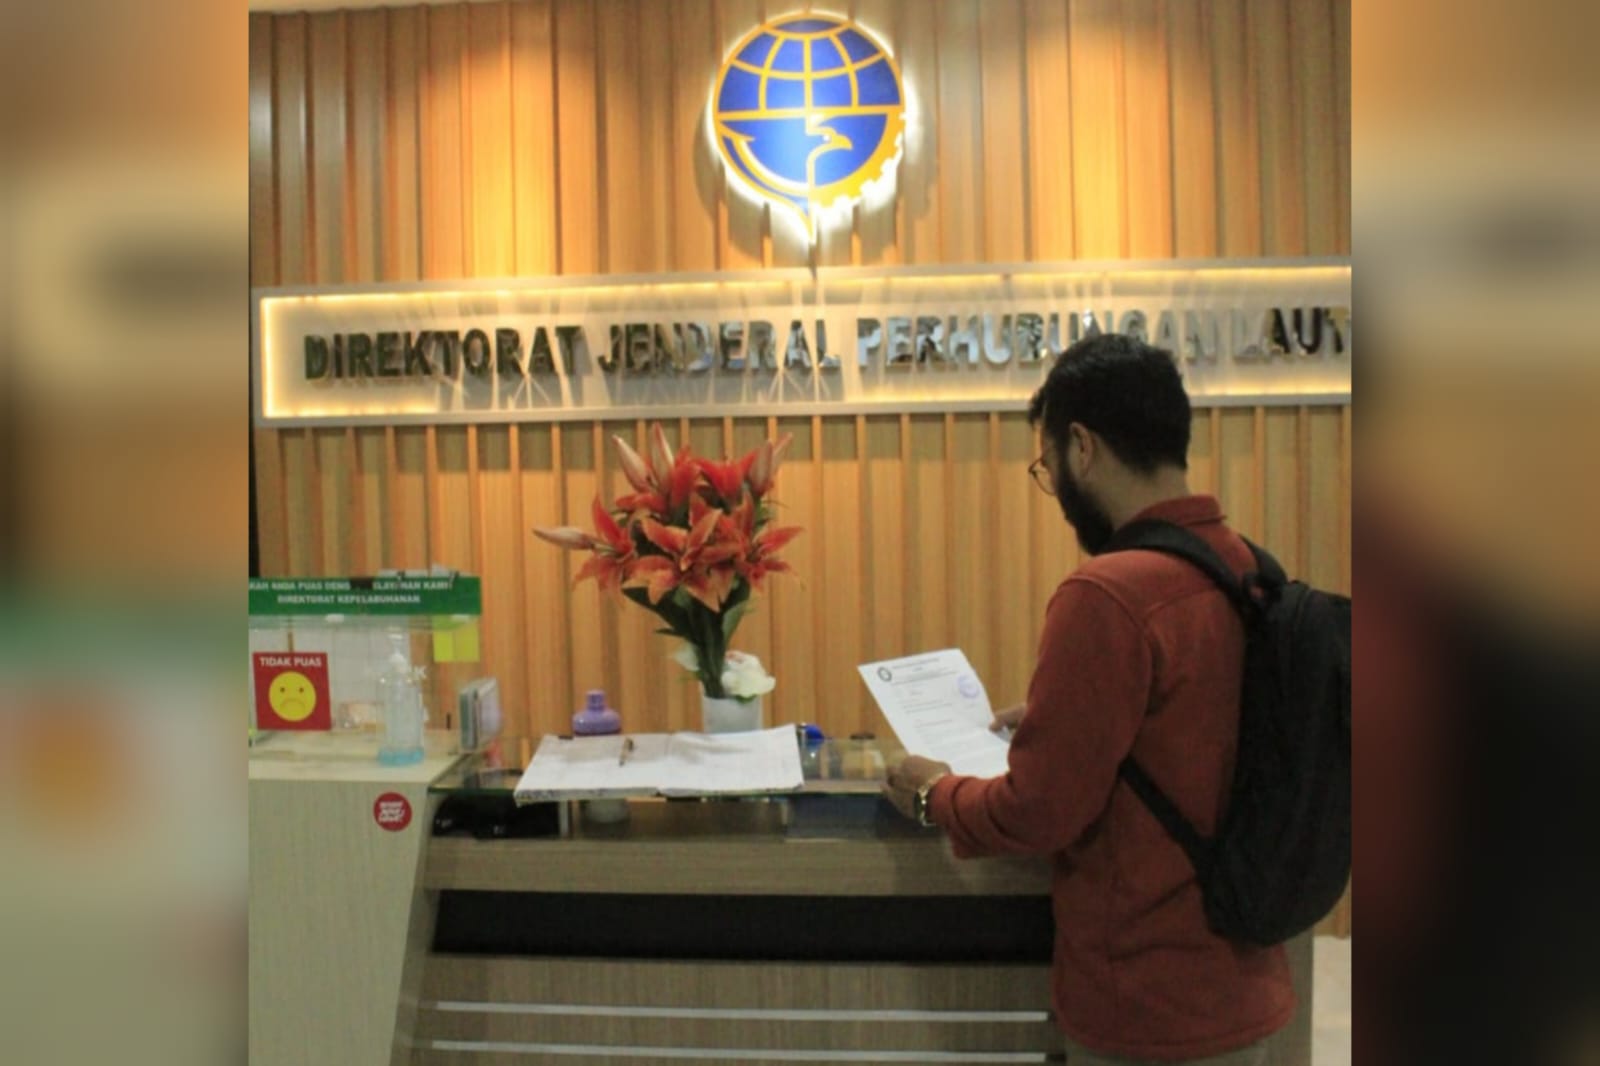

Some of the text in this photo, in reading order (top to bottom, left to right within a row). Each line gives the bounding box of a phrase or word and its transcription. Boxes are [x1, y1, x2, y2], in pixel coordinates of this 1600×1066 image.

[304, 325, 582, 380] DIREKTORAT
[597, 317, 840, 373] JENDERAL
[1231, 306, 1350, 362] LAUT
[324, 581, 351, 591] DENG
[260, 655, 322, 667] TIDAK PUAS
